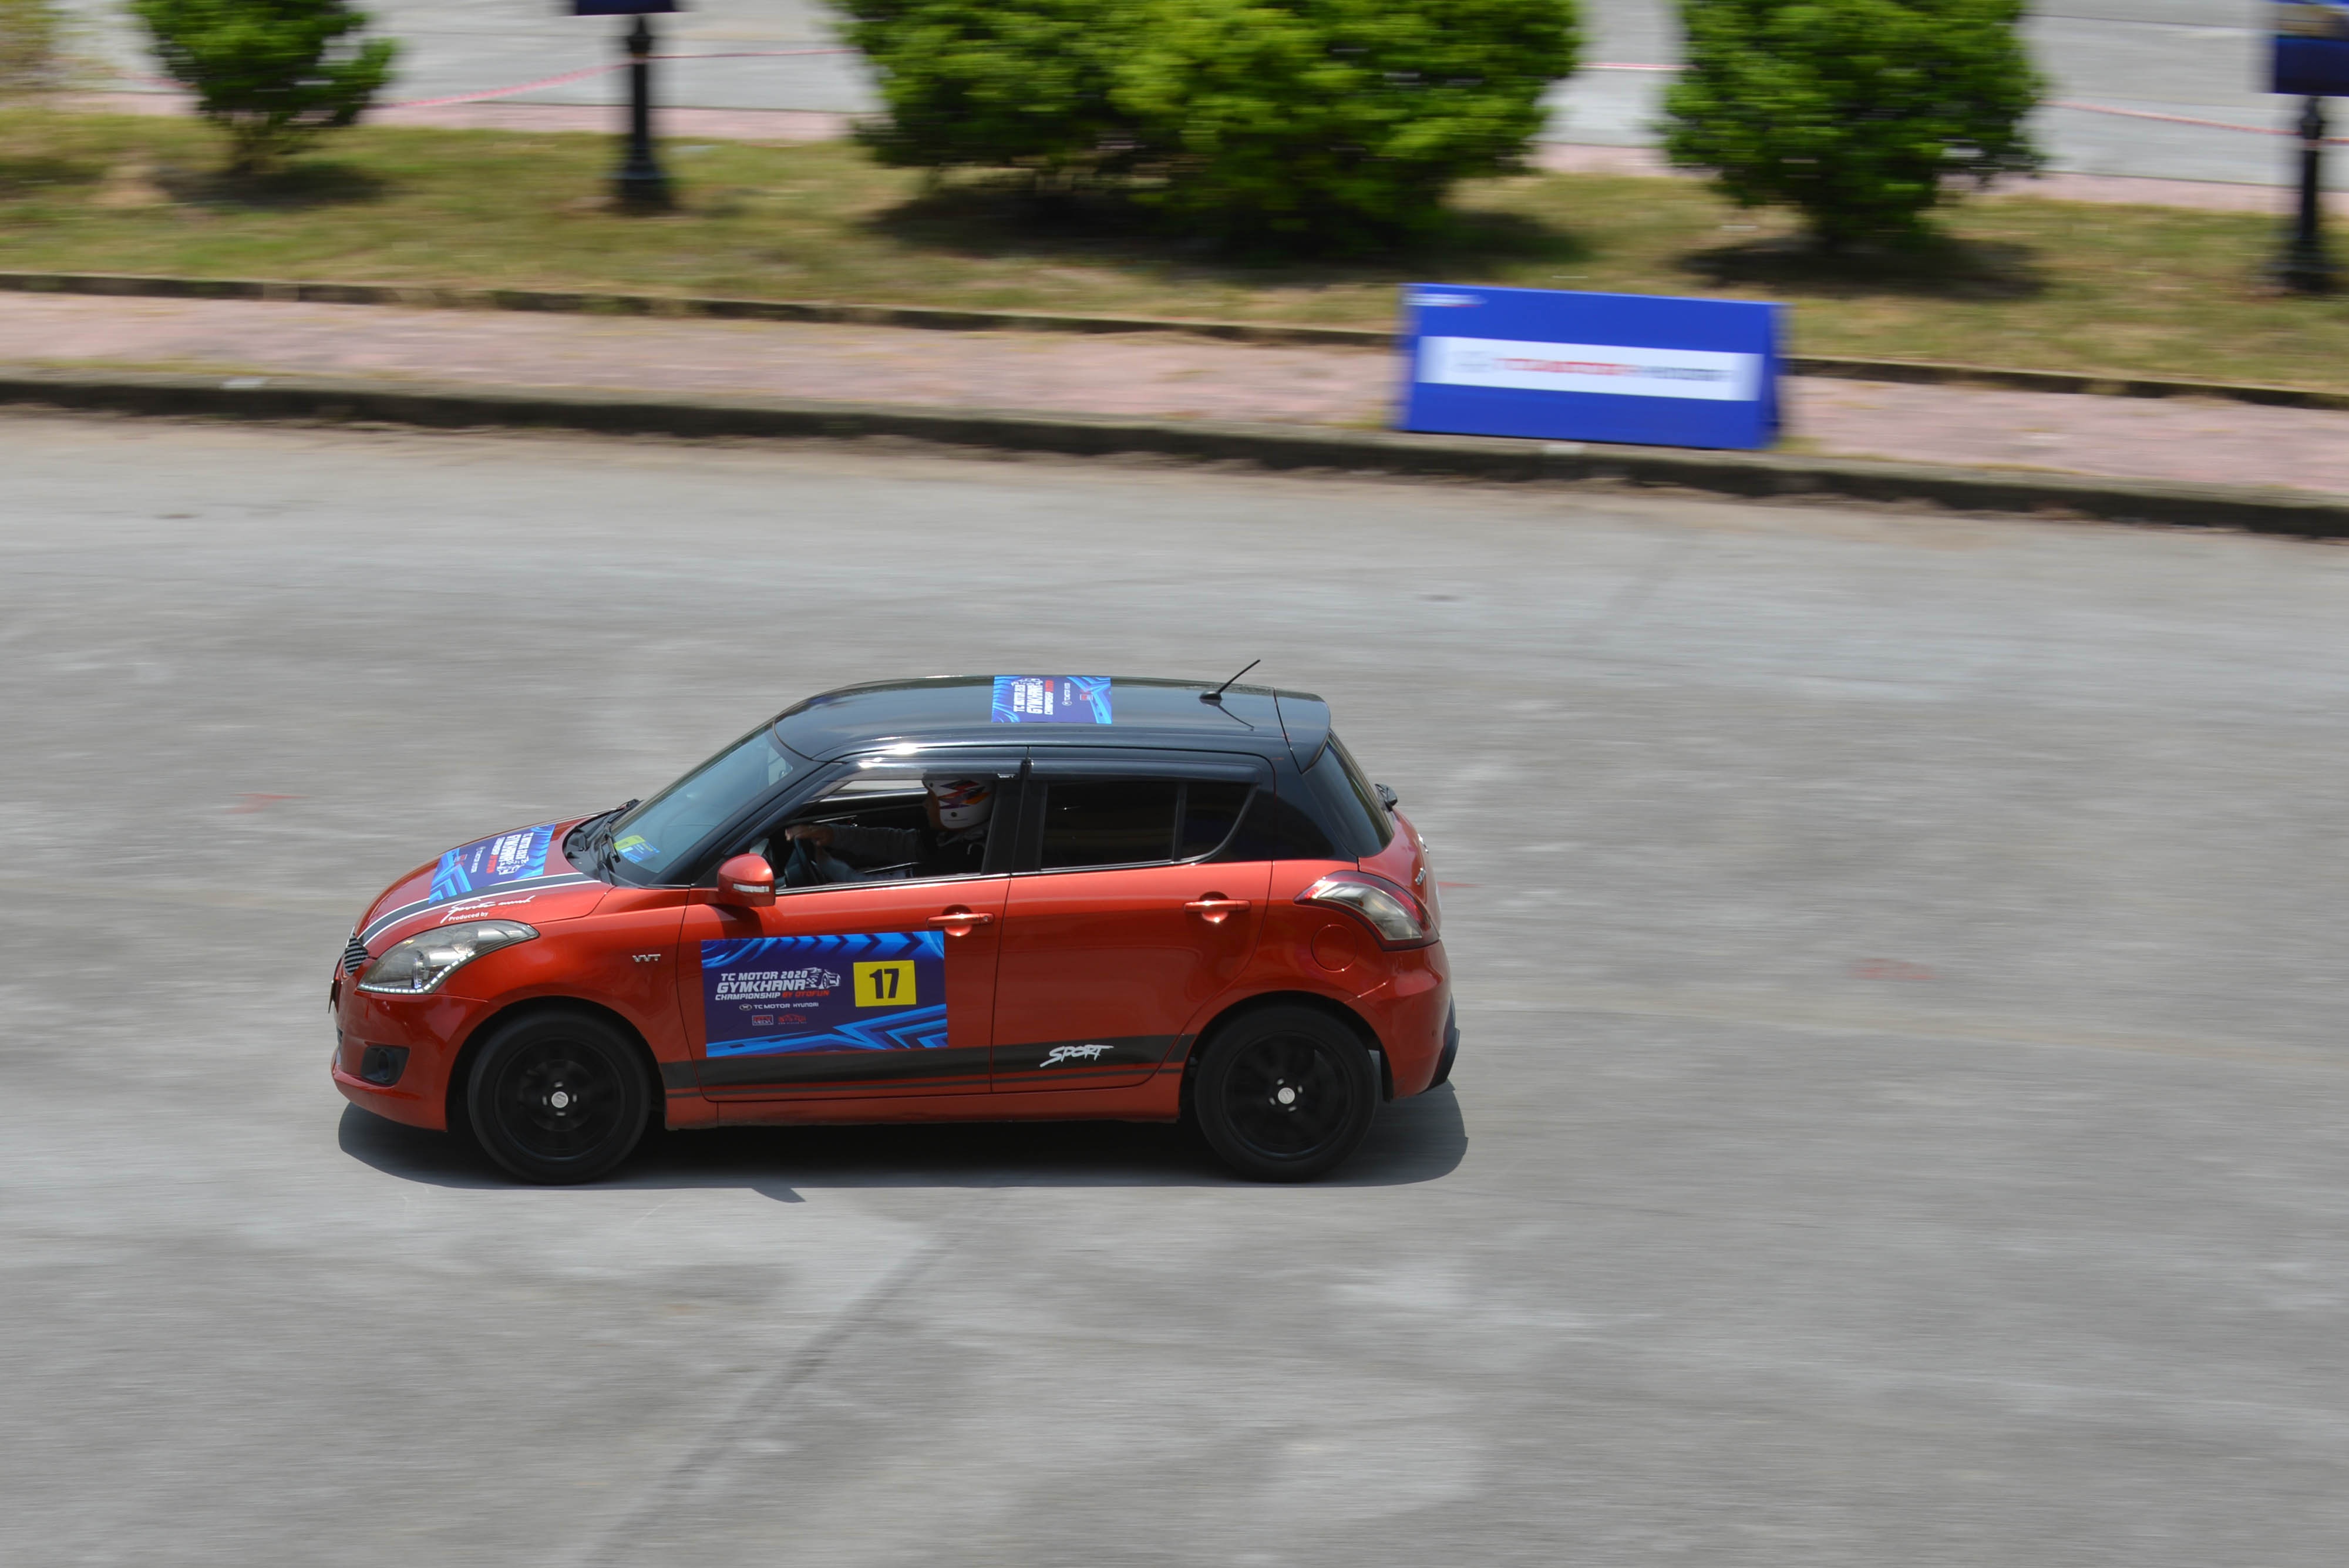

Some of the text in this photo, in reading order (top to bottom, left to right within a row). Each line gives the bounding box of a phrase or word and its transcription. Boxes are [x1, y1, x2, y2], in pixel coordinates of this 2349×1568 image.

[448, 912, 479, 921] Produced
[632, 954, 661, 963] VVT
[721, 970, 807, 981] TC MOTOR 2020
[716, 979, 806, 994] GYMKHANA
[869, 968, 899, 999] 17
[715, 992, 781, 1001] CHAMPIONSHIP
[1039, 1044, 1114, 1068] SPORT
